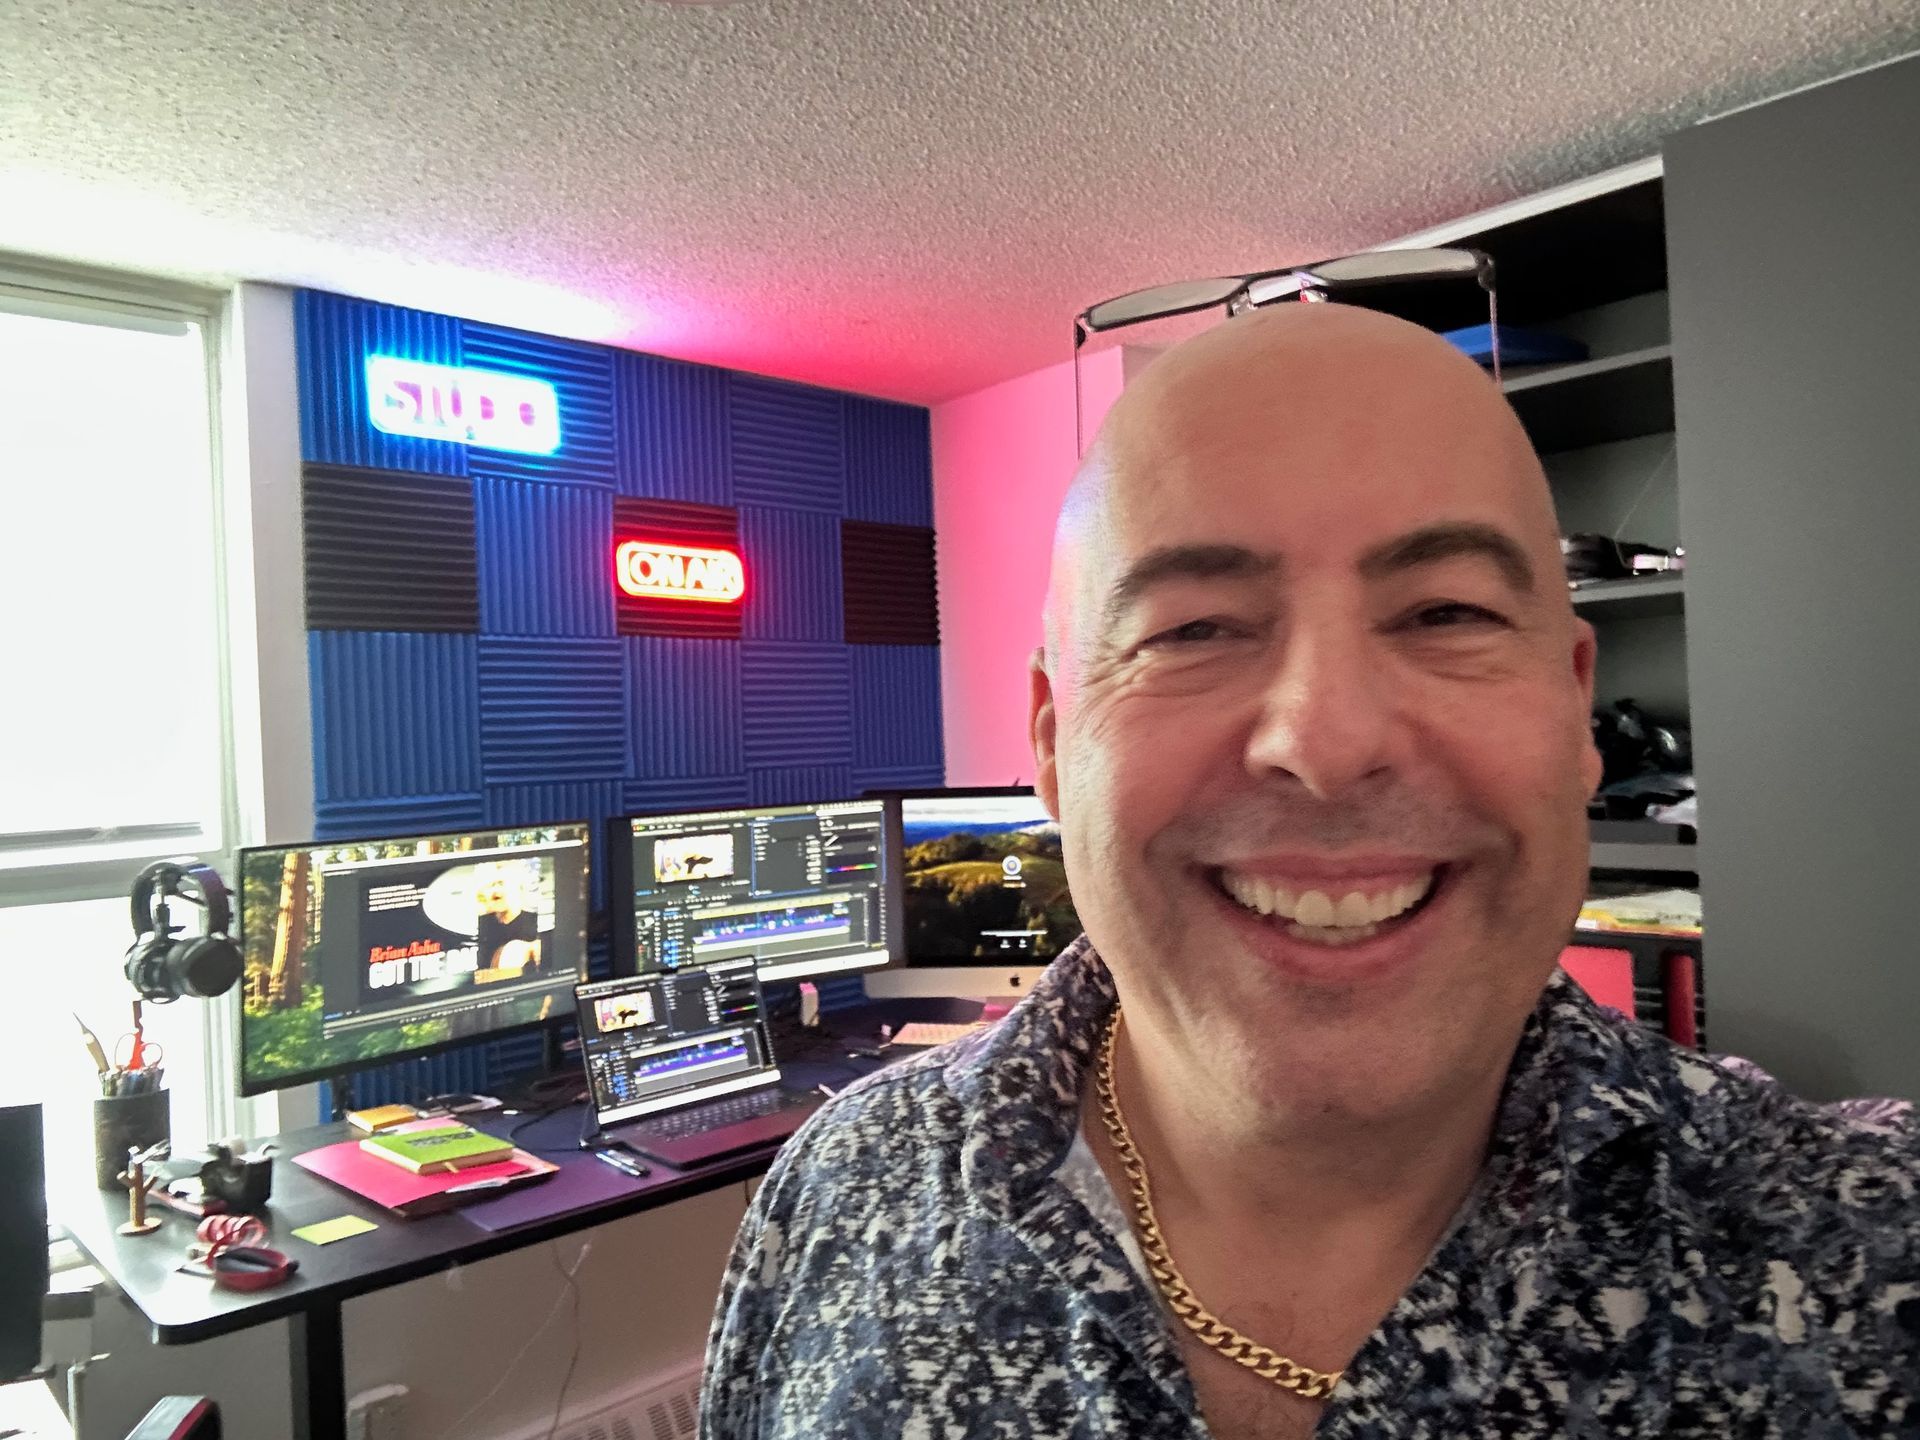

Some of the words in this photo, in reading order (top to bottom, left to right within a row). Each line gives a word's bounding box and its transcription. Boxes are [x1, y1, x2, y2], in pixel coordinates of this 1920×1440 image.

[370, 362, 553, 446] STUDO
[629, 551, 686, 589] ON
[369, 946, 408, 963] Brian
